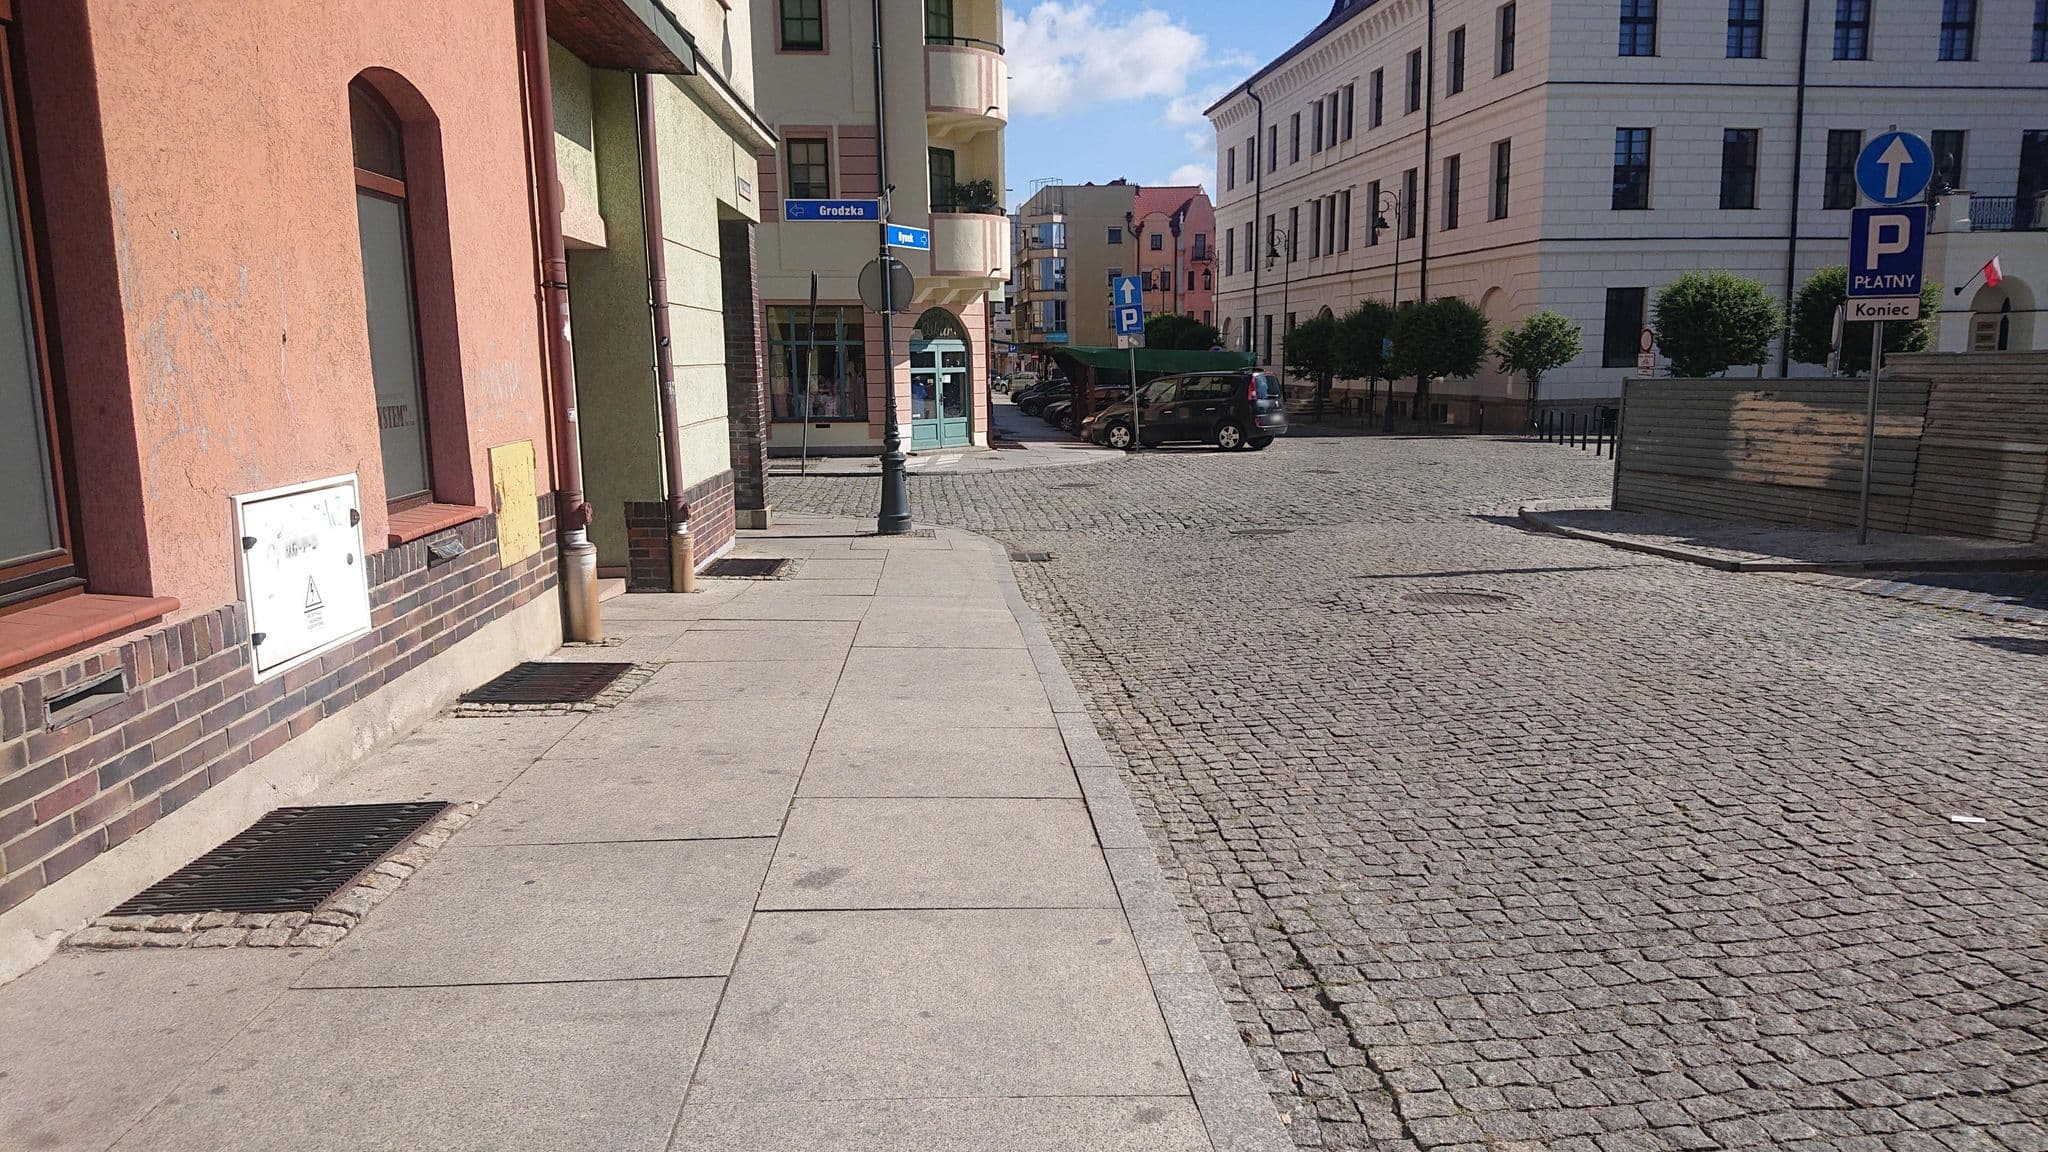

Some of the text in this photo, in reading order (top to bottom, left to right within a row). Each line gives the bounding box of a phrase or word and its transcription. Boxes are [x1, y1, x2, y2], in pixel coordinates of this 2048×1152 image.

[819, 205, 865, 217] Grodzka
[1866, 214, 1911, 270] P
[1855, 274, 1915, 289] PŁATNY
[1855, 303, 1910, 317] Koniec
[1121, 308, 1139, 331] P
